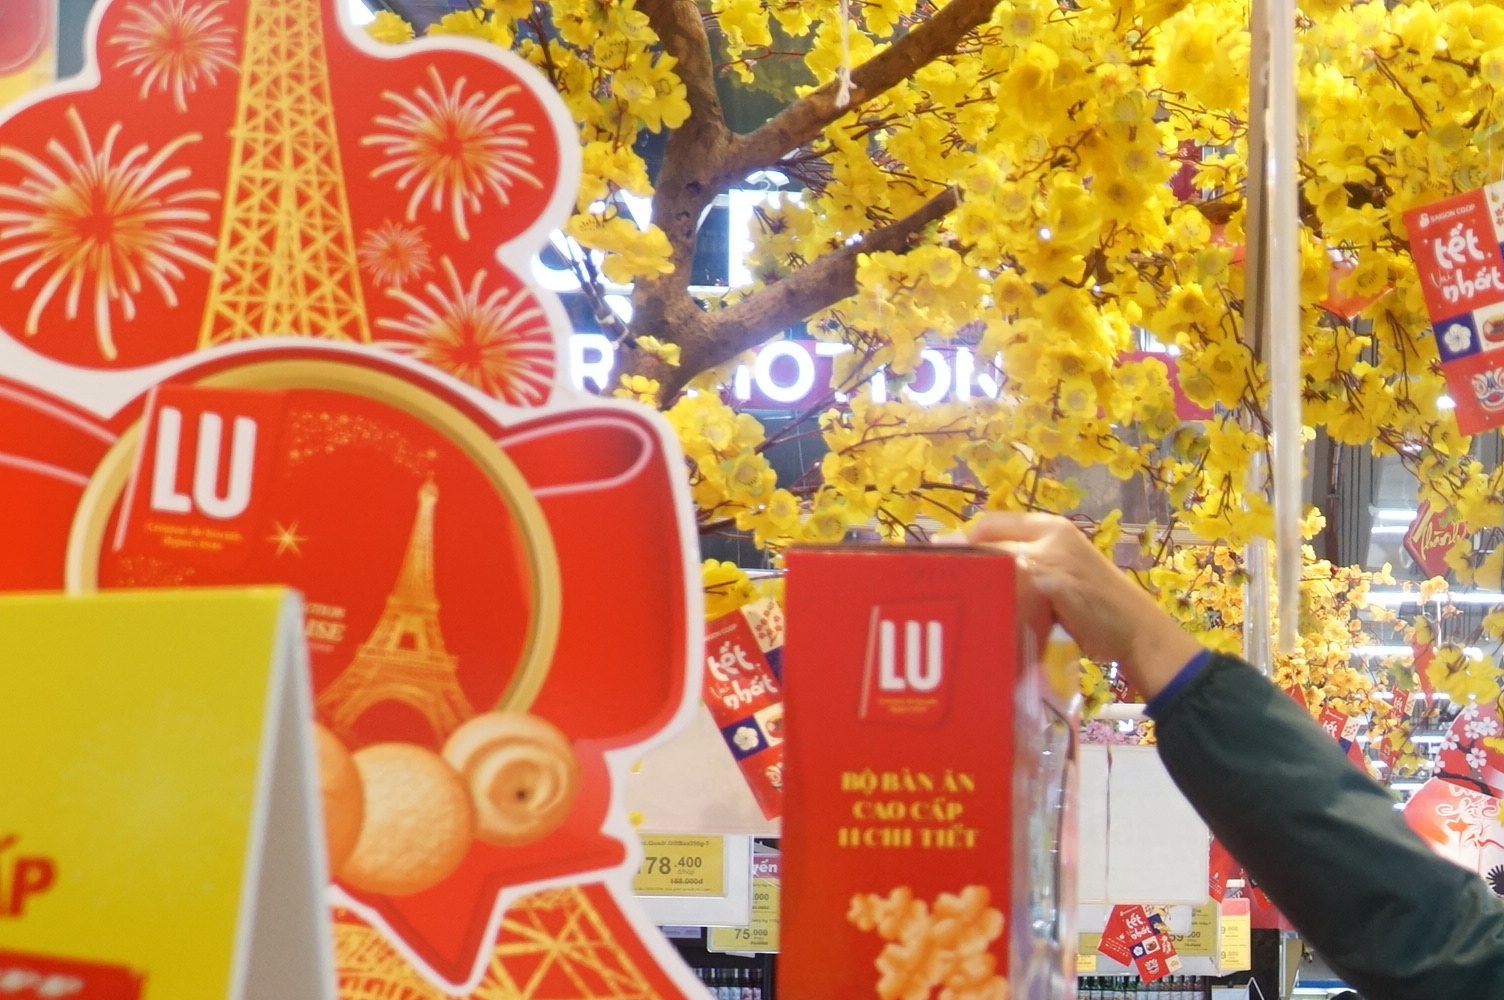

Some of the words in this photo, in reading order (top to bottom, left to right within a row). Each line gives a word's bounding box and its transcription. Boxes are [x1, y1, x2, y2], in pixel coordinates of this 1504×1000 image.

[1430, 209, 1456, 226] SAIGON
[1433, 222, 1486, 270] tết
[151, 404, 258, 520] LU
[707, 640, 756, 682] tết
[878, 618, 944, 691] LU
[722, 675, 779, 710] nhất
[638, 856, 702, 876] 78.400
